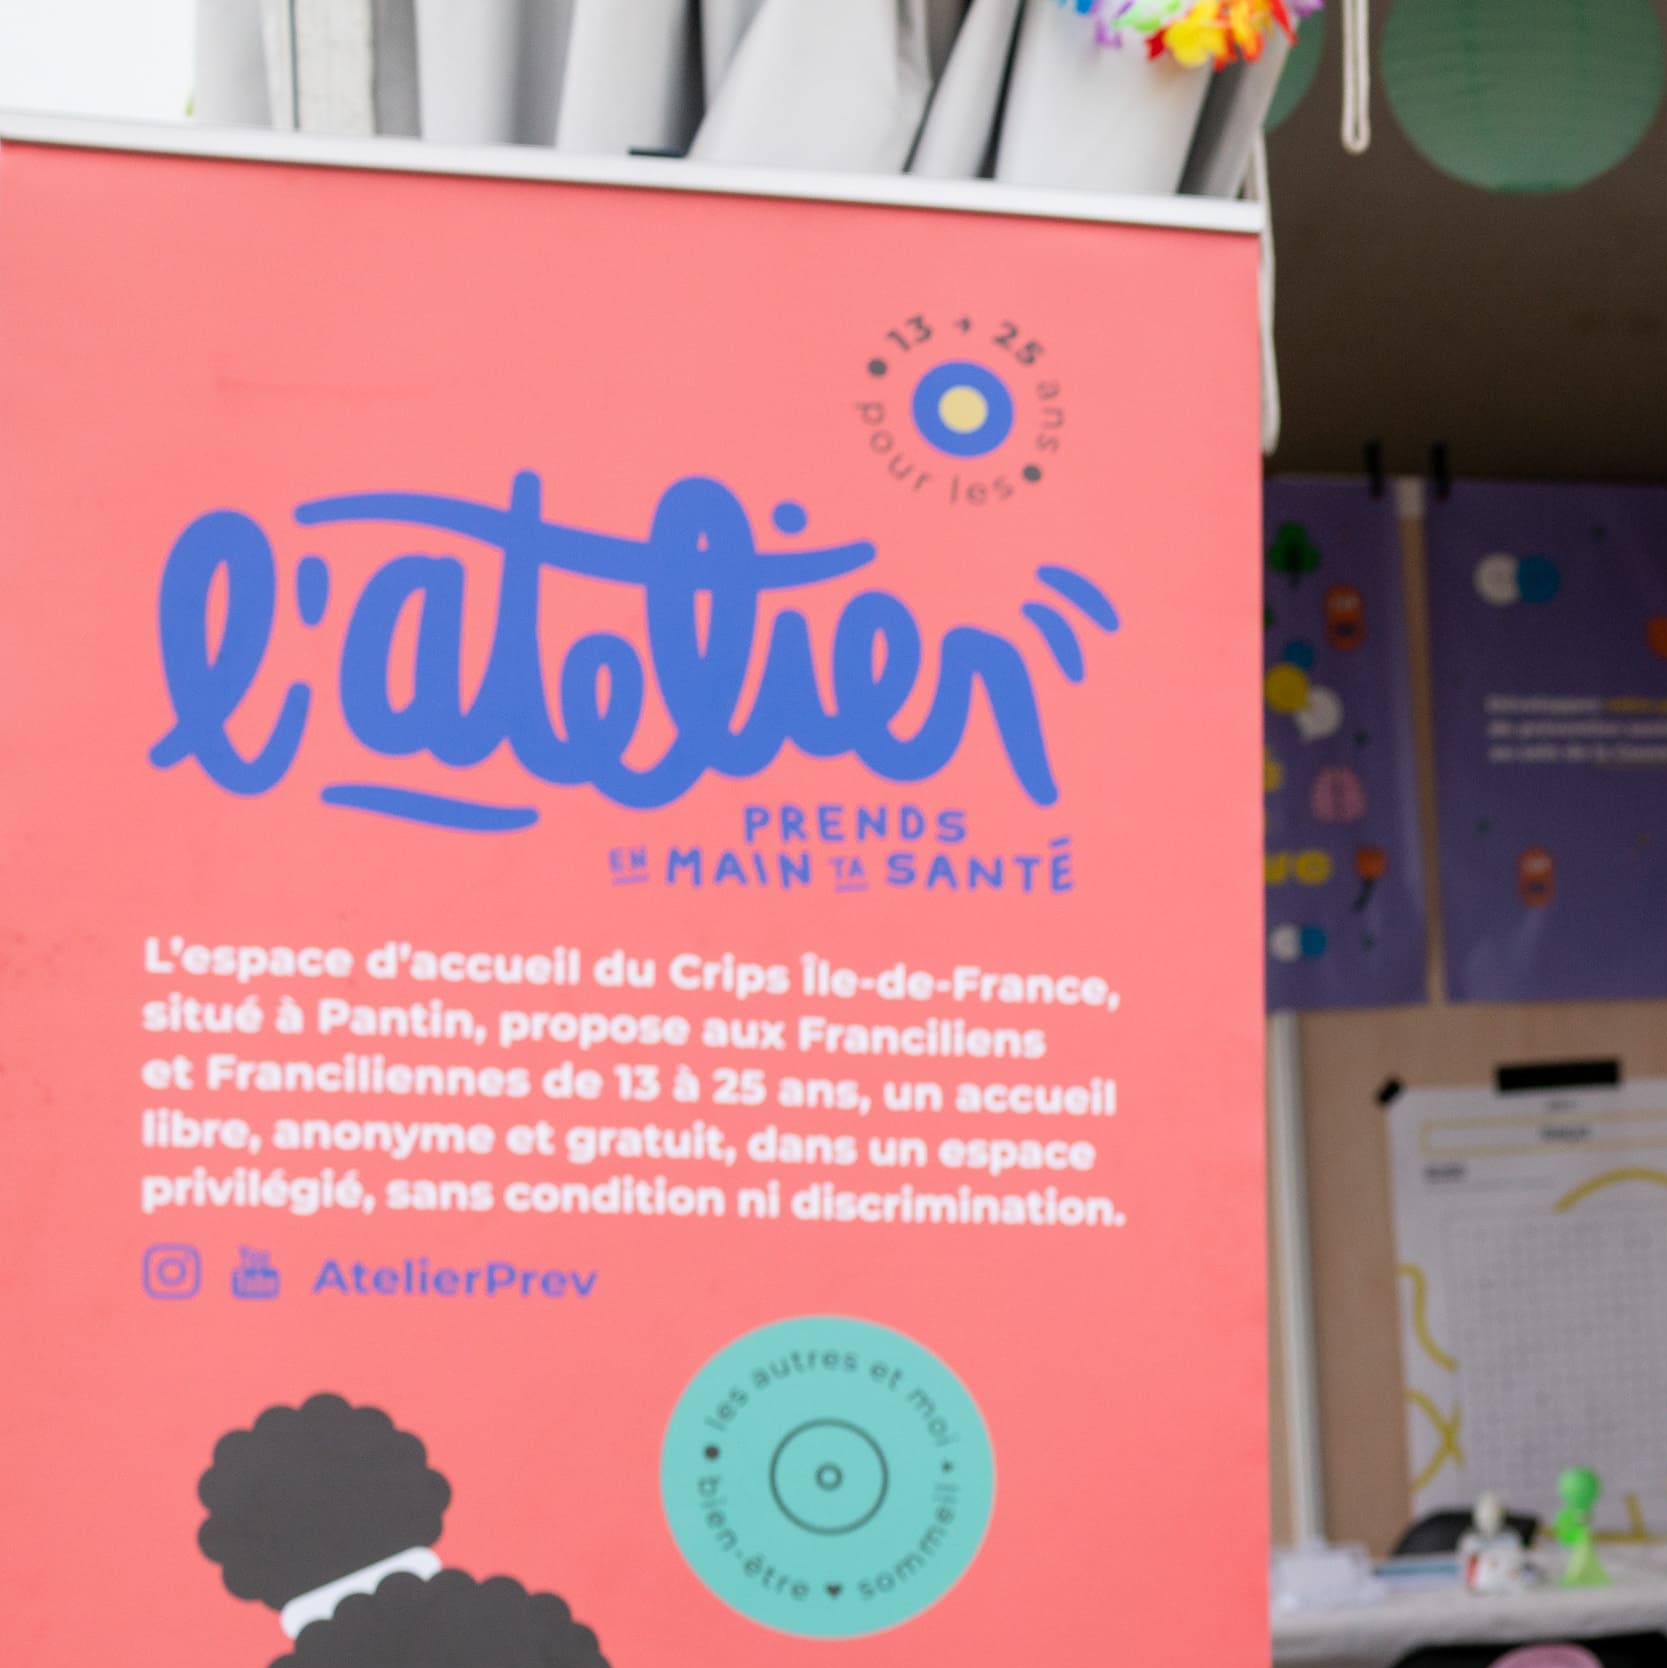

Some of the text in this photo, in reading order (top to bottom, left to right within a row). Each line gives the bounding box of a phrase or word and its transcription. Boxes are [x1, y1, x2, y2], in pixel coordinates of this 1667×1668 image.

[884, 314, 1066, 455] 13 25 ans
[852, 401, 1015, 507] pour les
[743, 804, 968, 844] PRENDS
[608, 837, 1075, 895] EN MAIN TA SANTÉ
[144, 935, 1121, 1012] L'espace d'accueil du Crips Île-de-France,
[142, 991, 1047, 1060] situé à Pantin, propose aux Franciliens
[141, 1052, 1117, 1116] et Franciliennes de 13 à 25 ans, un accueil
[141, 1107, 1097, 1177] libre, anonyme et gratuit, dans un espace
[141, 1165, 1127, 1227] privilégié, sans condition ni discrimination.
[312, 1256, 599, 1300] AtelierPrev
[703, 1349, 962, 1449] les autres et moi
[697, 1475, 812, 1602] bien-être
[857, 1482, 960, 1603] sommeil
